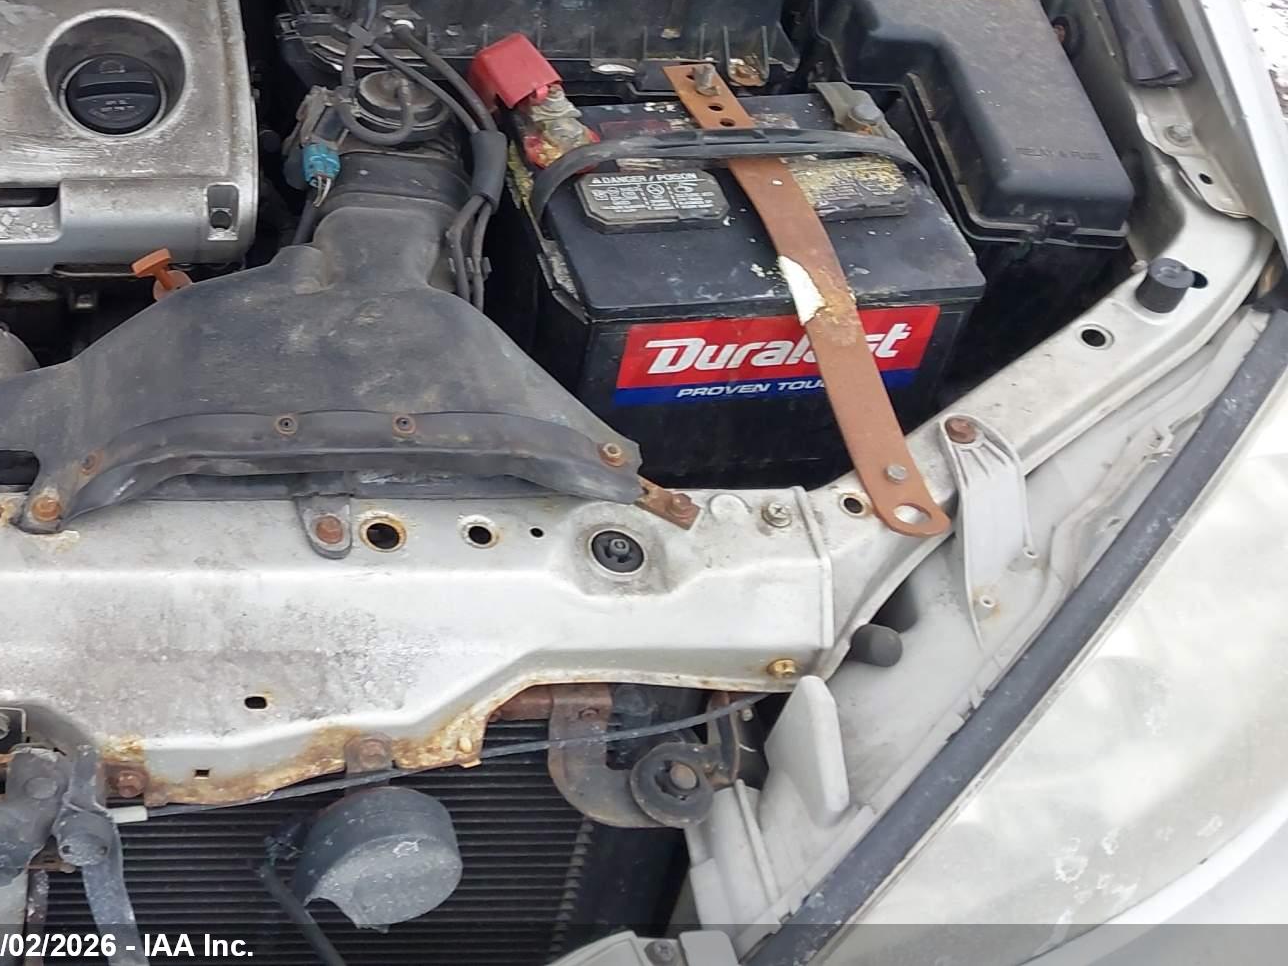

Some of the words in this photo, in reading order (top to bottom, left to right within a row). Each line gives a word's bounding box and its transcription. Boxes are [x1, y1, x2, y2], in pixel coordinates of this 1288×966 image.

[601, 175, 647, 184] DANGER
[656, 173, 698, 181] POISON
[645, 323, 912, 375] Duralt
[676, 383, 772, 398] PROVEN
[777, 379, 825, 391] TOU
